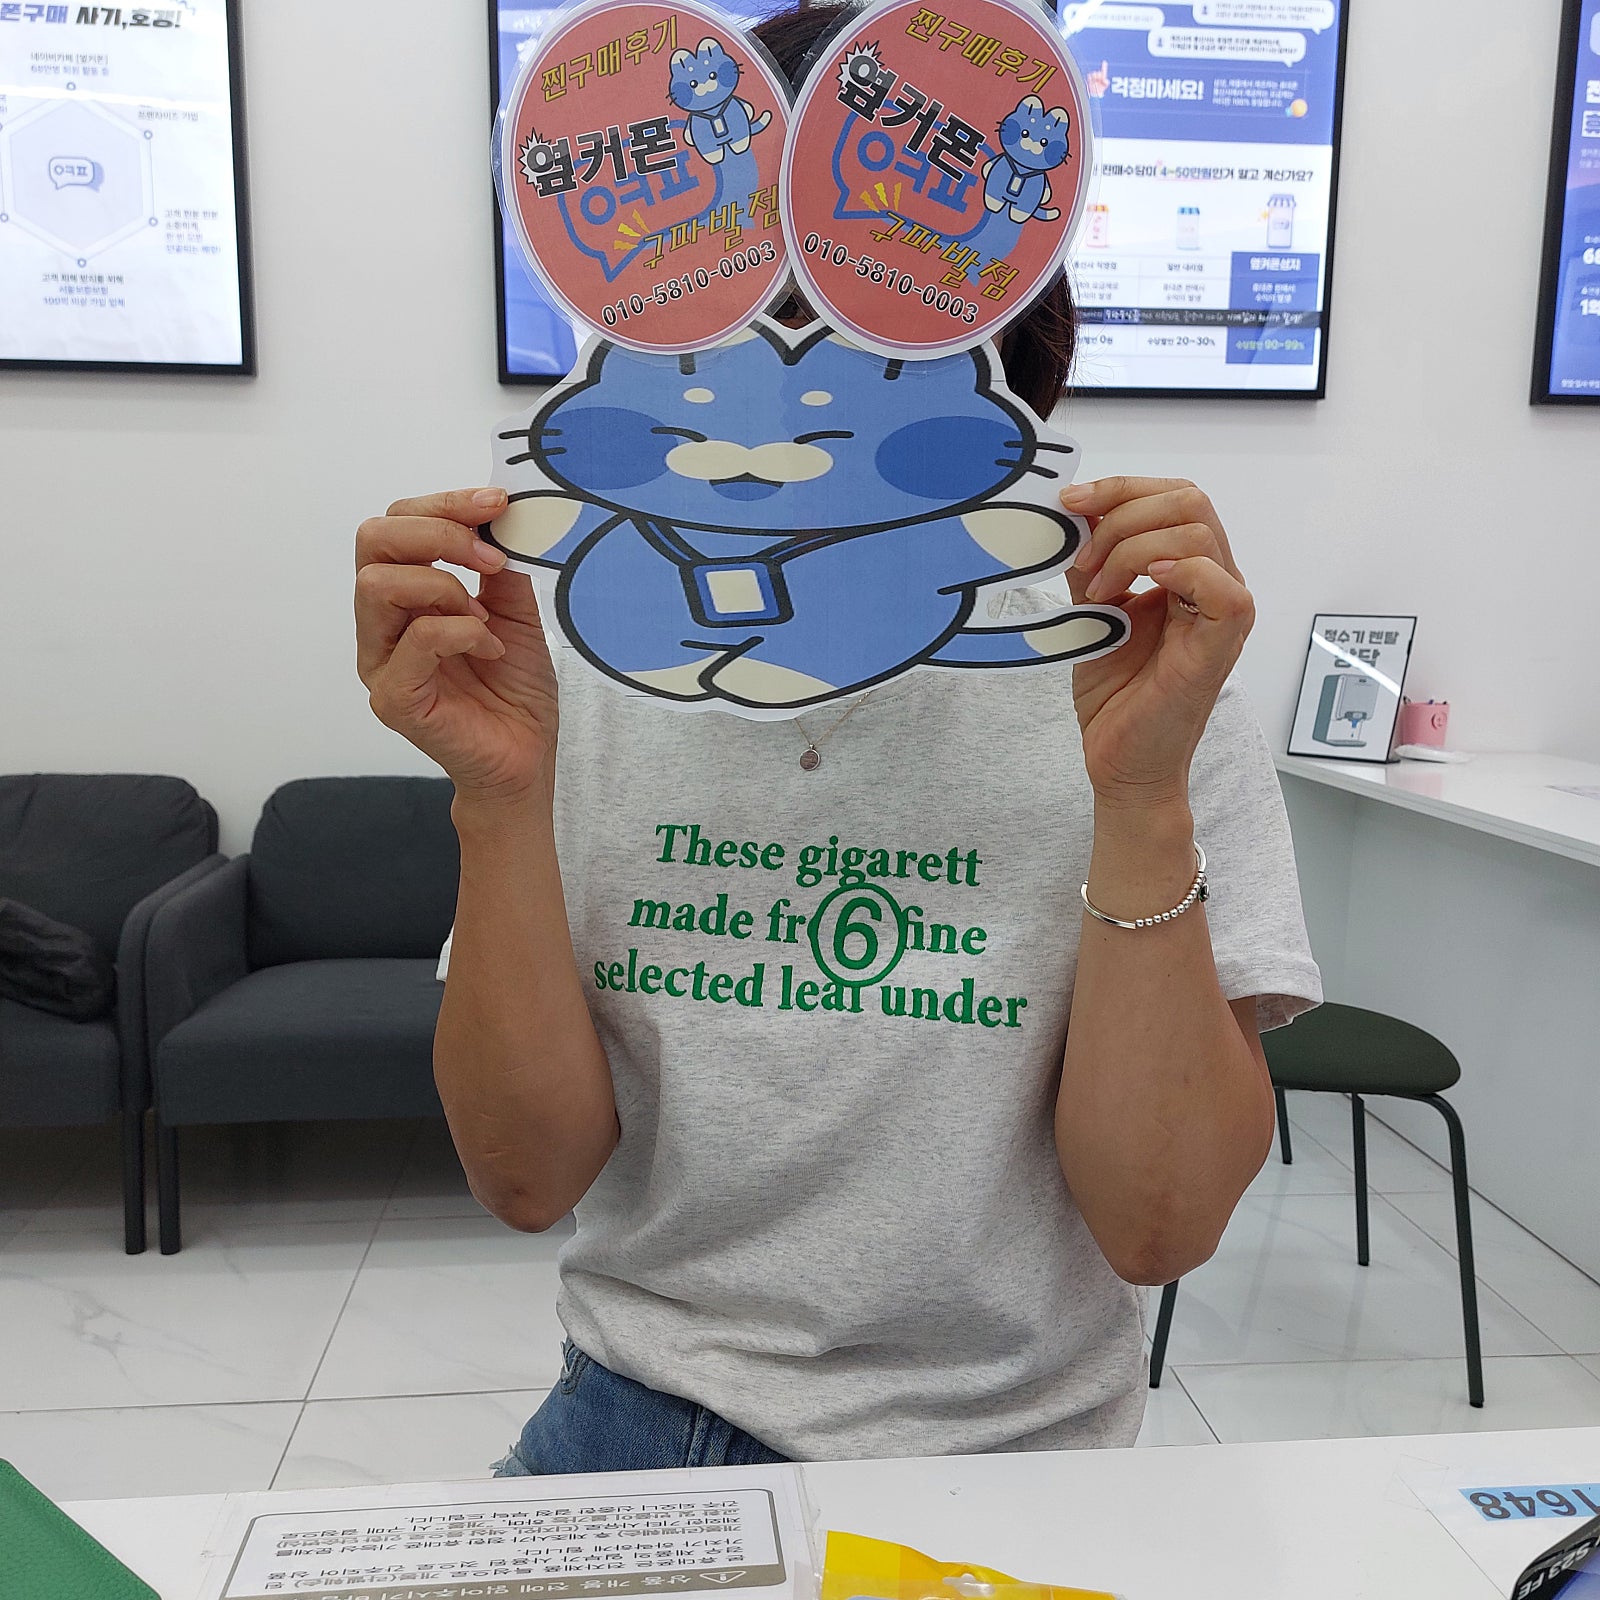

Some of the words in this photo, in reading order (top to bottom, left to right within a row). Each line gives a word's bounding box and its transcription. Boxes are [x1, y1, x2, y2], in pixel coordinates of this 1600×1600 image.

[541, 15, 678, 102] 찐구매후기
[905, 8, 1058, 93] 찐구매후기
[1111, 76, 1205, 100] 걱정마세요!
[836, 54, 987, 183] 옆커폰
[525, 115, 677, 198] 옆커폰
[1263, 168, 1314, 182] 계신가요?
[602, 240, 776, 326] 010-5810-0003
[804, 232, 979, 325] 010-5810-0003
[1324, 629, 1365, 644] 정수기
[1368, 630, 1399, 645] 렌탈
[654, 823, 786, 871] These
[795, 835, 983, 888] gigarett
[627, 893, 754, 940] made
[594, 948, 765, 1008] selected
[880, 977, 1028, 1028] under
[511, 1533, 588, 1543] 제조사가
[517, 1545, 585, 1556] 됩니다.
[594, 1541, 675, 1552] 하락하게
[683, 1538, 744, 1547] 가치가
[1548, 1541, 1591, 1579] S23
[520, 1581, 569, 1594] 전에
